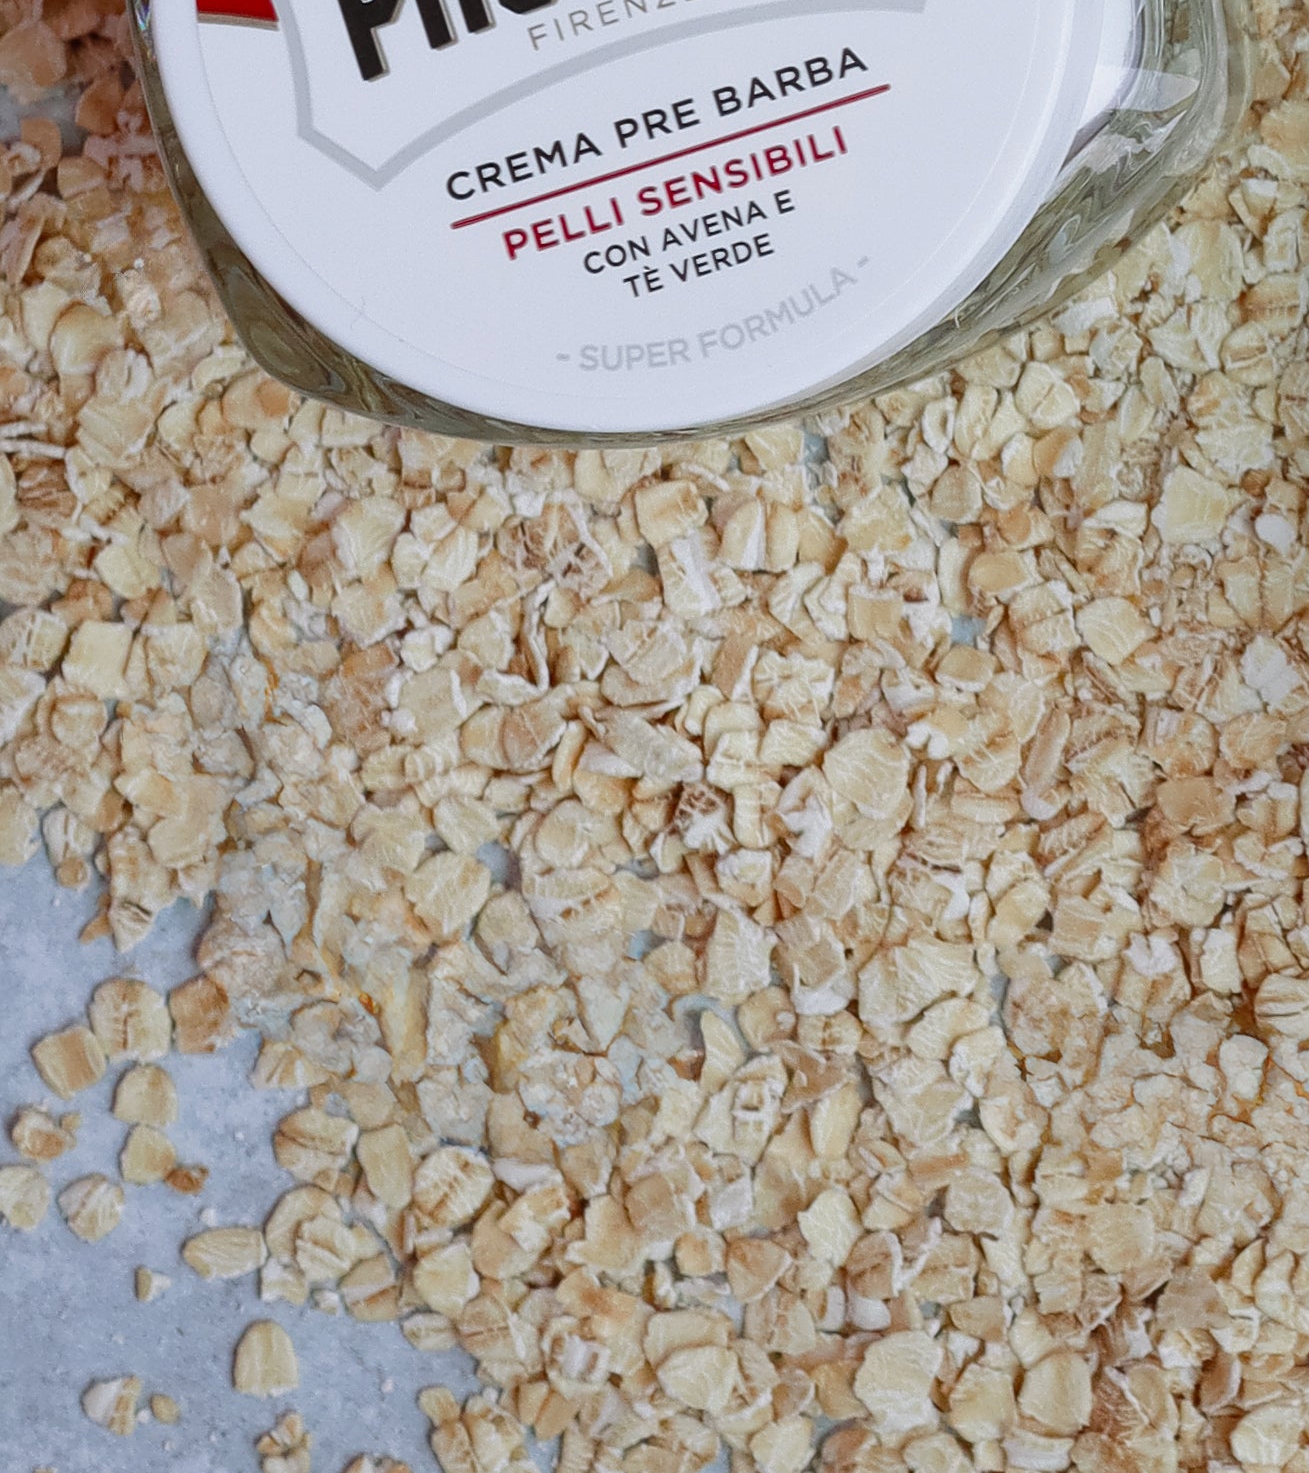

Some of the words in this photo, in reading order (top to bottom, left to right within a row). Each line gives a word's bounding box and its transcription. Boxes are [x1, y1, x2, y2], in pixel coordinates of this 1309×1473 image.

[446, 132, 603, 201] CREMA
[613, 98, 700, 149] PRE
[712, 47, 868, 117] BARBA
[502, 197, 624, 261] PELLI
[637, 126, 847, 216] SENSIBILI
[583, 236, 651, 275] CON
[662, 200, 768, 252] AVENA
[773, 189, 795, 215] E
[622, 265, 664, 297] TÈ
[669, 232, 775, 283] VERDE
[578, 337, 692, 372] SUPER
[696, 267, 858, 359] FORMULA
